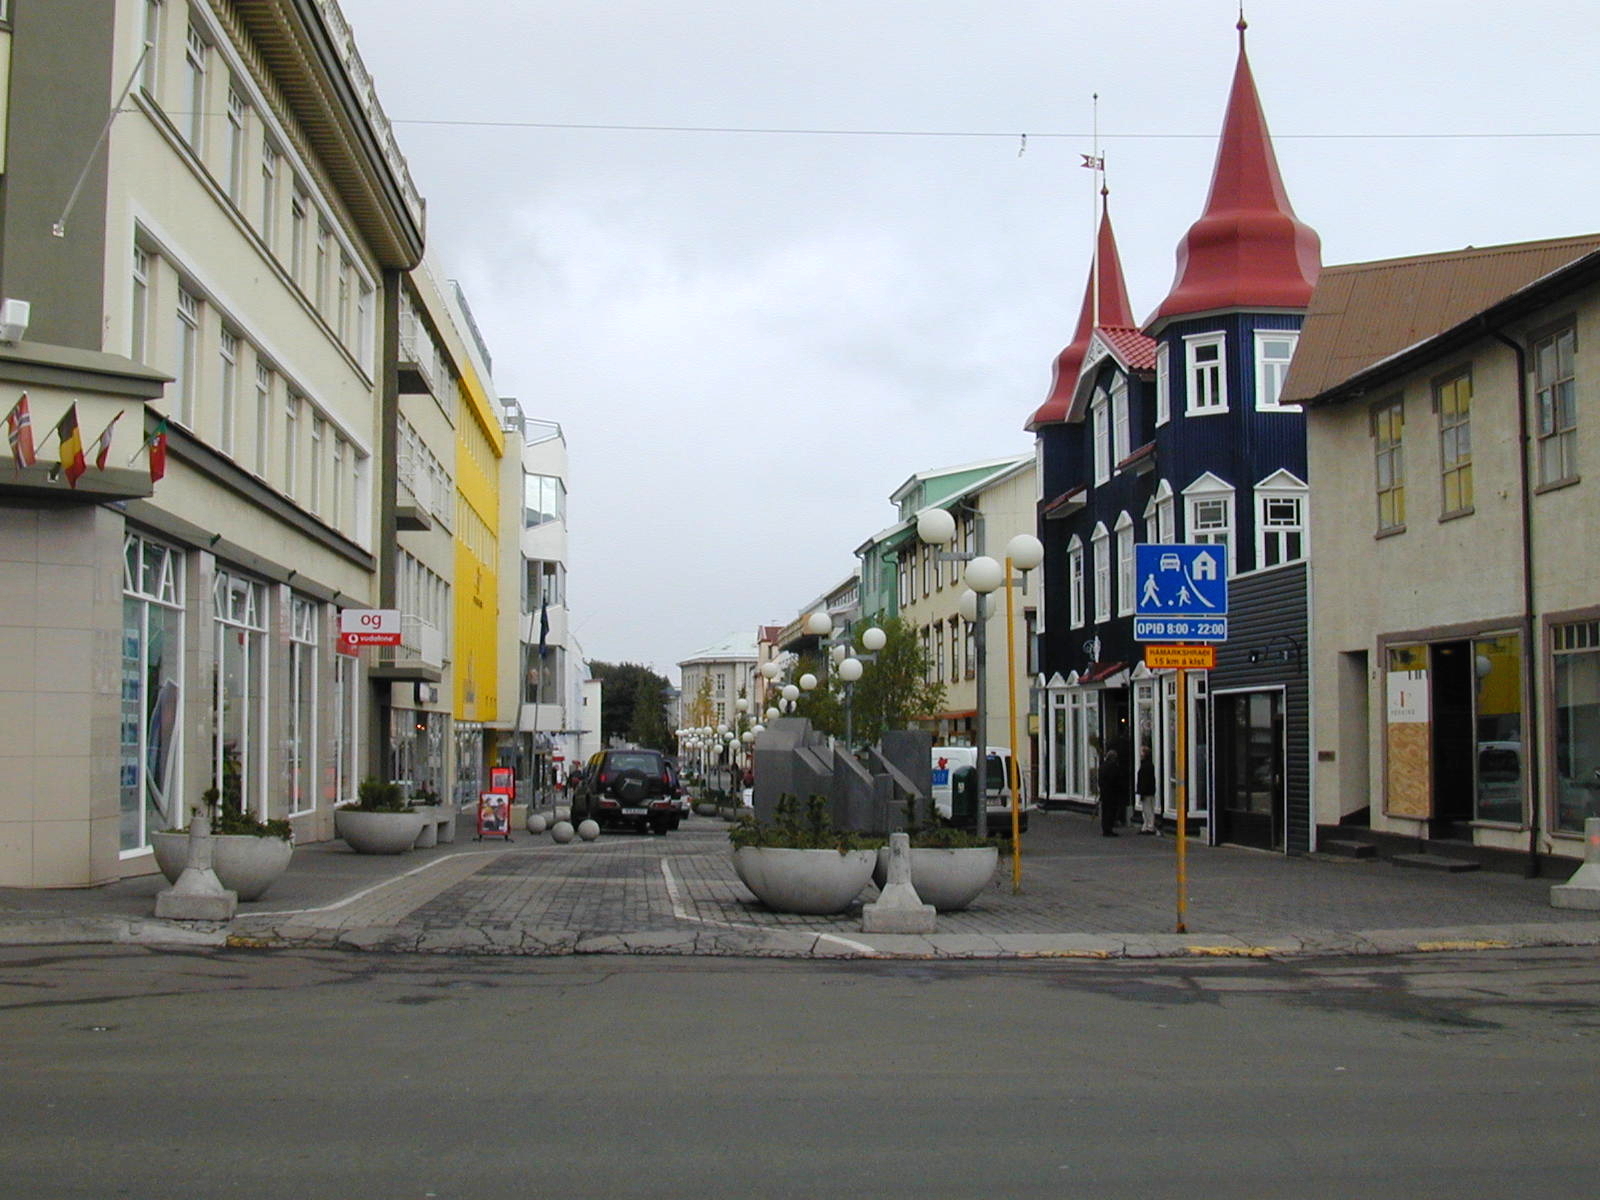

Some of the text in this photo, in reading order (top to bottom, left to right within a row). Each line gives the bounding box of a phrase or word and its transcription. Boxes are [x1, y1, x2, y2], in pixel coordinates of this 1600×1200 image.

[361, 614, 381, 630] og
[1137, 623, 1165, 634] OPIÐ
[1167, 623, 1189, 634] 8:00
[1197, 623, 1224, 635] 22:00
[1166, 657, 1179, 665] km
